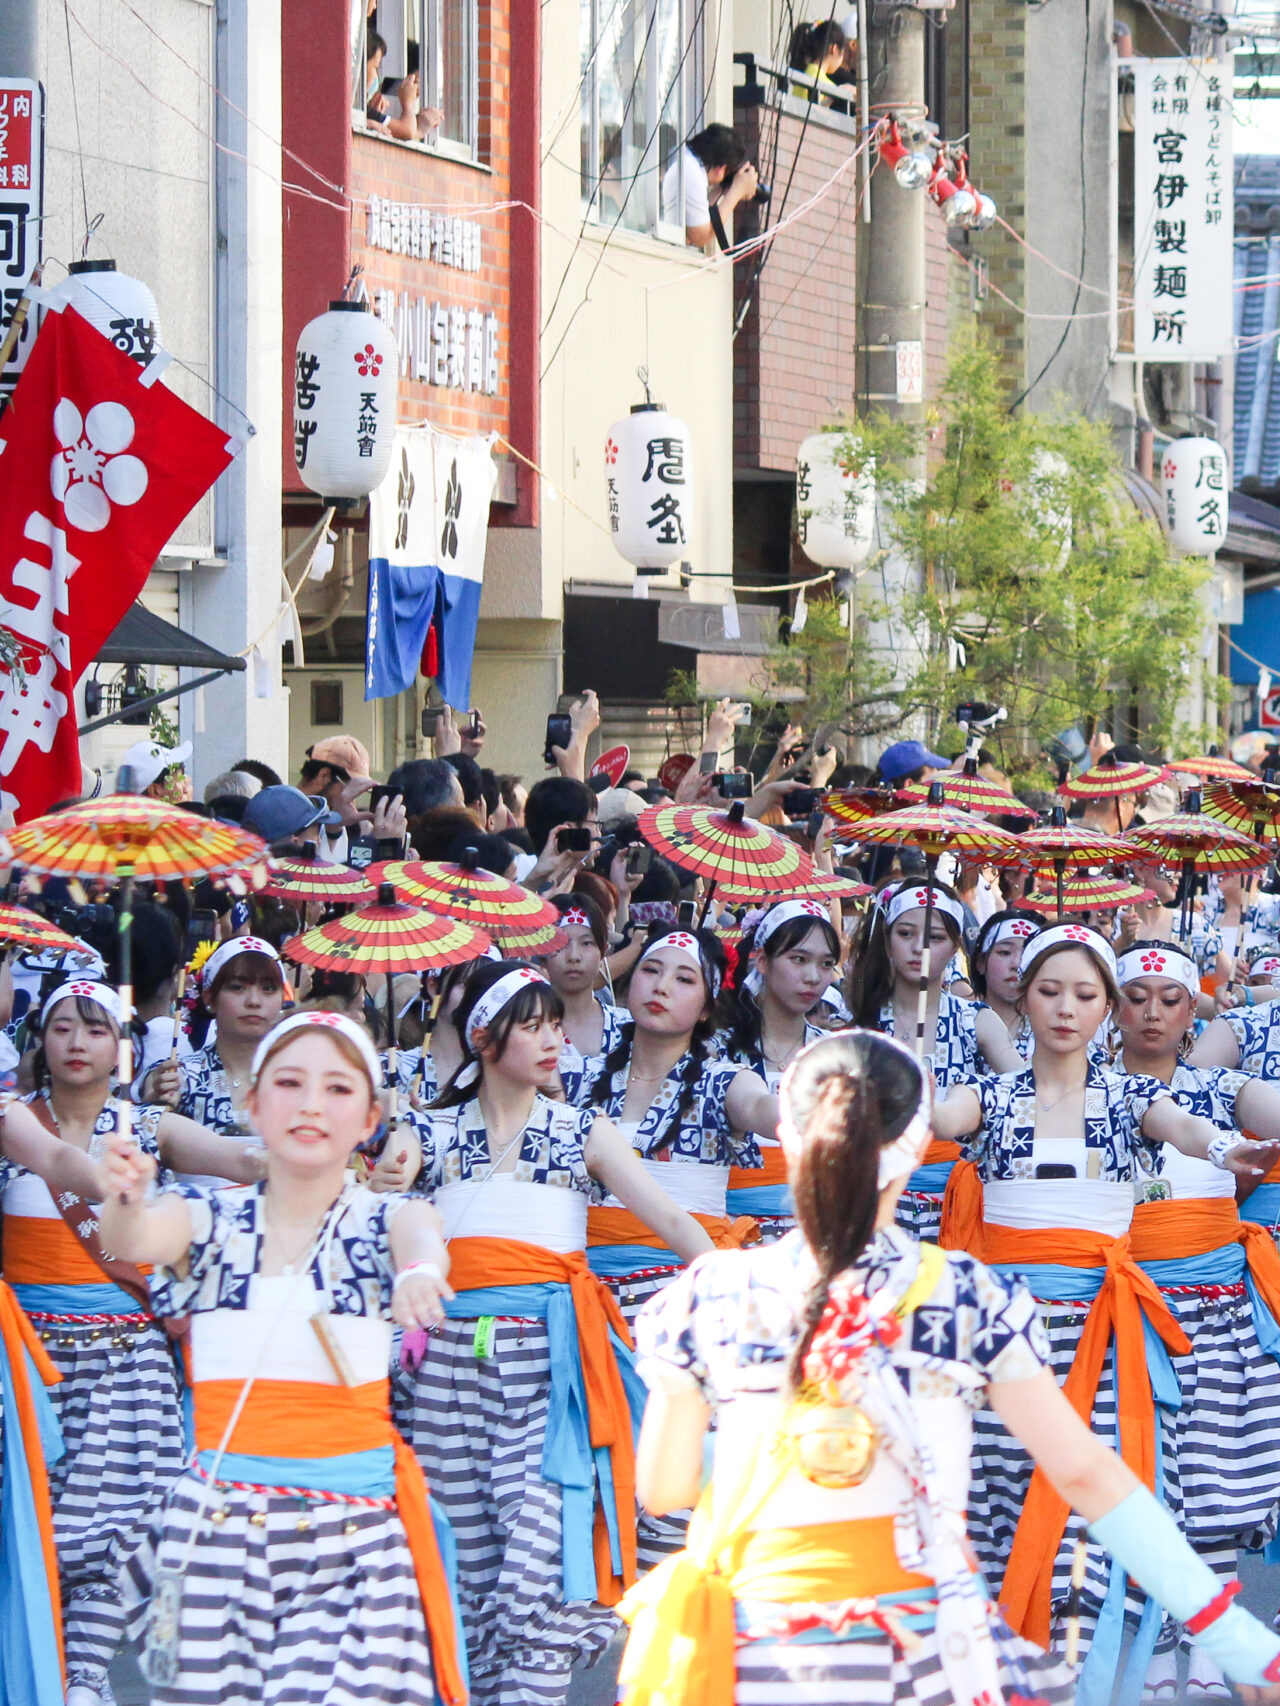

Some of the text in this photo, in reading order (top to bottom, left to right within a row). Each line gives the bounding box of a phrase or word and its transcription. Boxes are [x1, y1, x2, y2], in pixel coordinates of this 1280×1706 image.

[11, 94, 30, 187] 内科
[1152, 75, 1168, 114] 会社
[1173, 75, 1189, 114] 有限
[1205, 75, 1222, 226] 各種うどんそば卸
[1153, 128, 1189, 344] 宮伊製麺所
[353, 279, 499, 397] 小山包装商店
